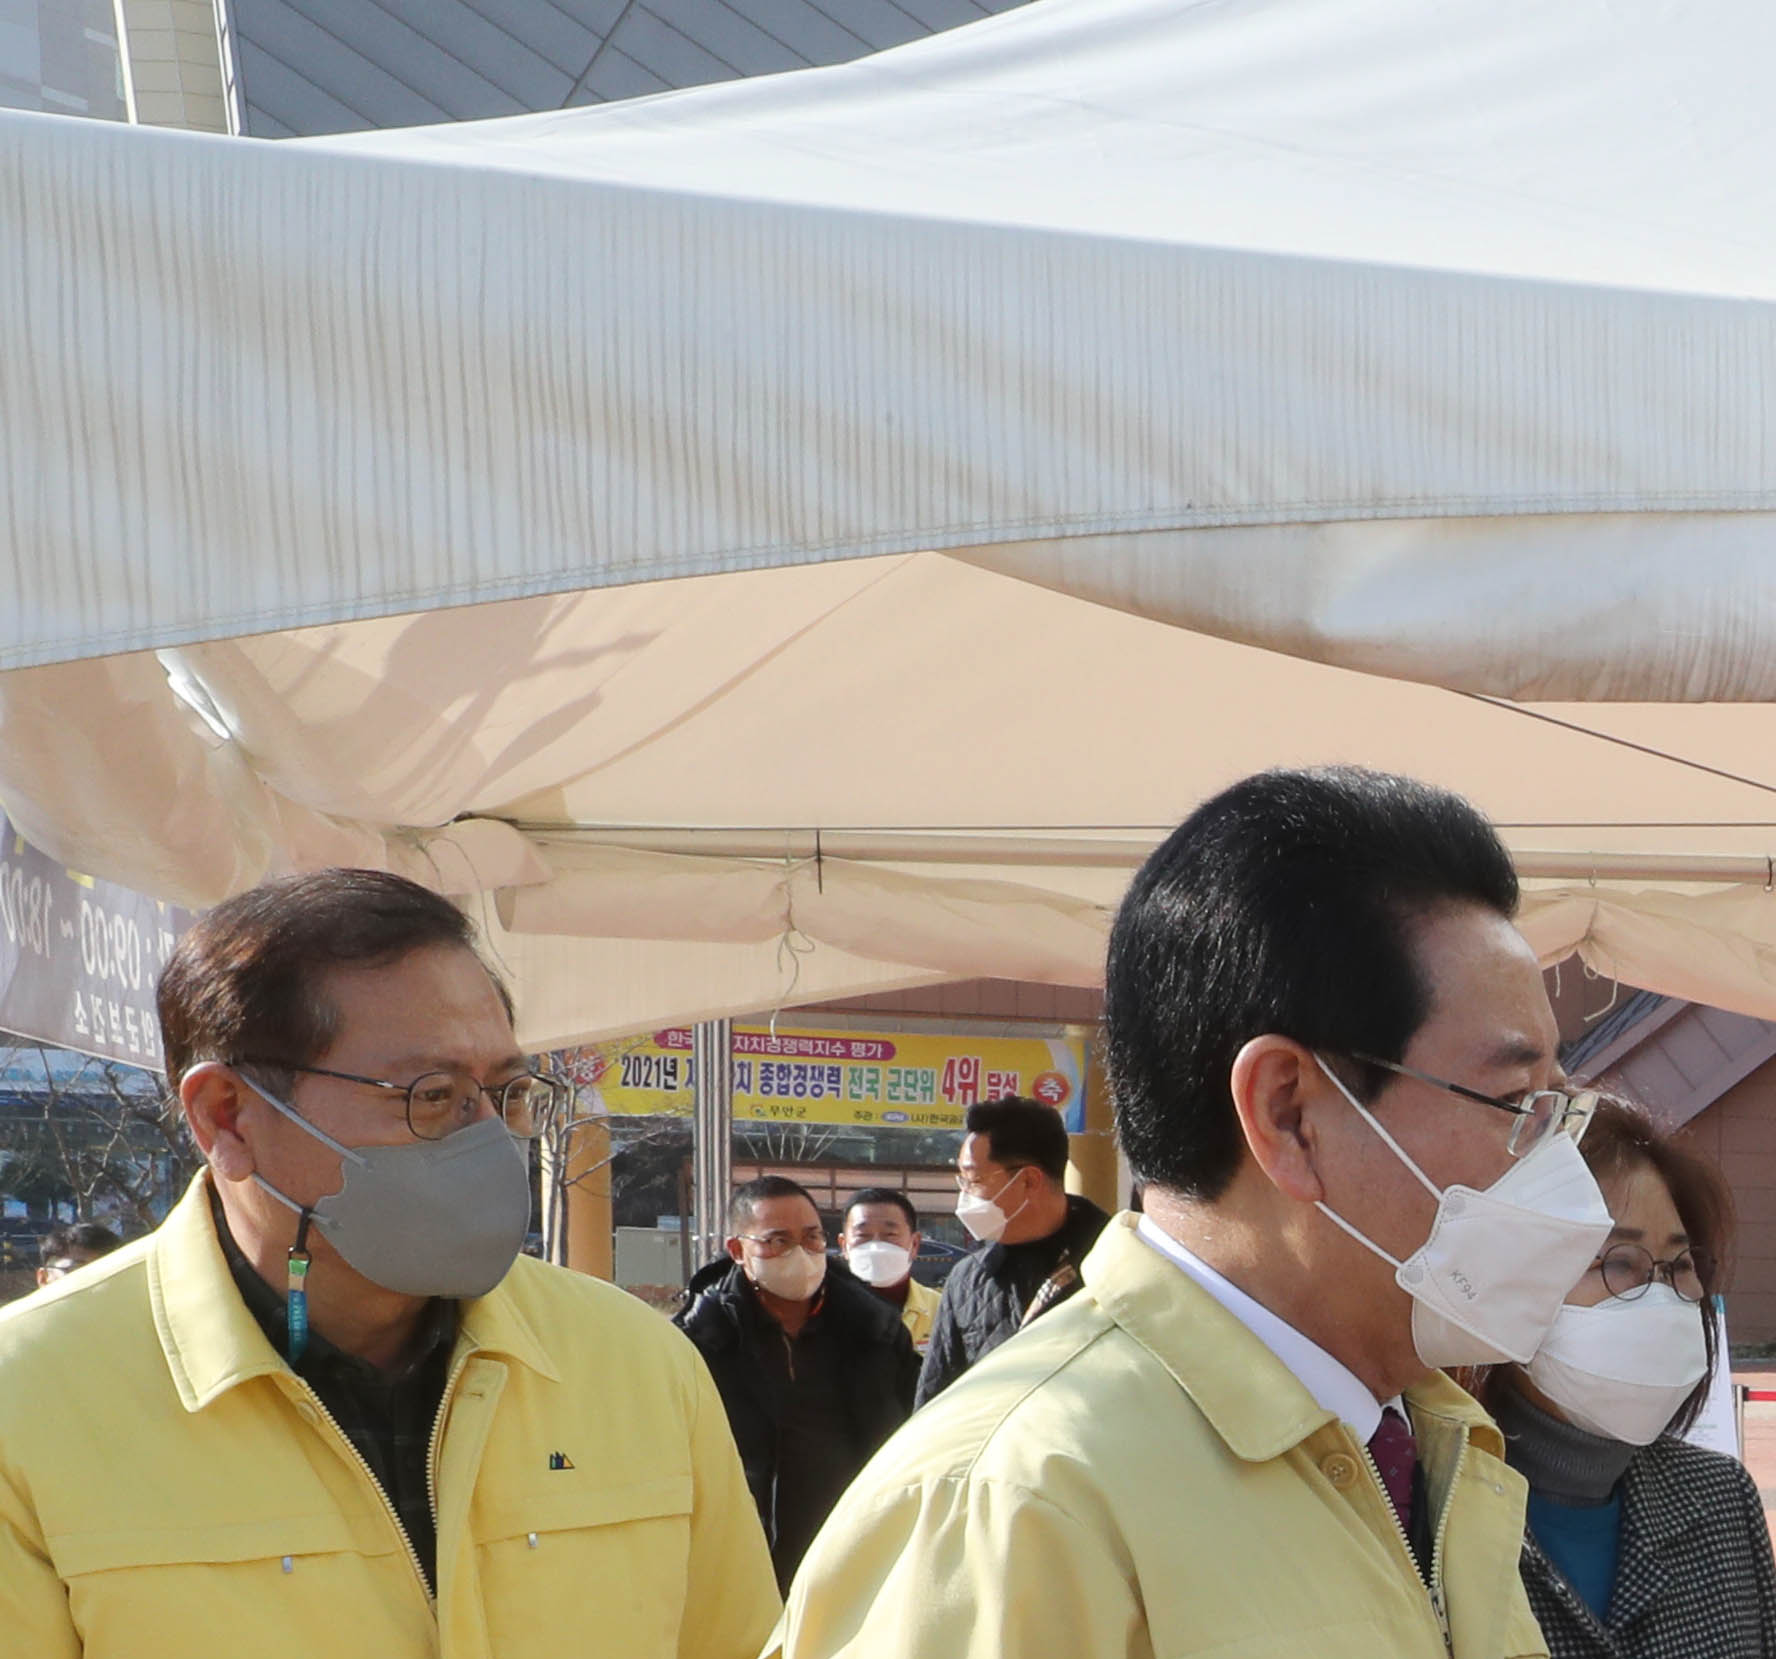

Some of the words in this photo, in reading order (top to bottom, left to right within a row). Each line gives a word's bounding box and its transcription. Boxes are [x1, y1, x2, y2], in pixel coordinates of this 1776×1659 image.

[620, 1055, 679, 1090] 2021년
[759, 1062, 842, 1099] 종합경쟁력
[848, 1067, 880, 1101] 전국
[887, 1068, 935, 1103] 군단위
[942, 1057, 979, 1106] 4위
[1038, 1078, 1063, 1101] 축
